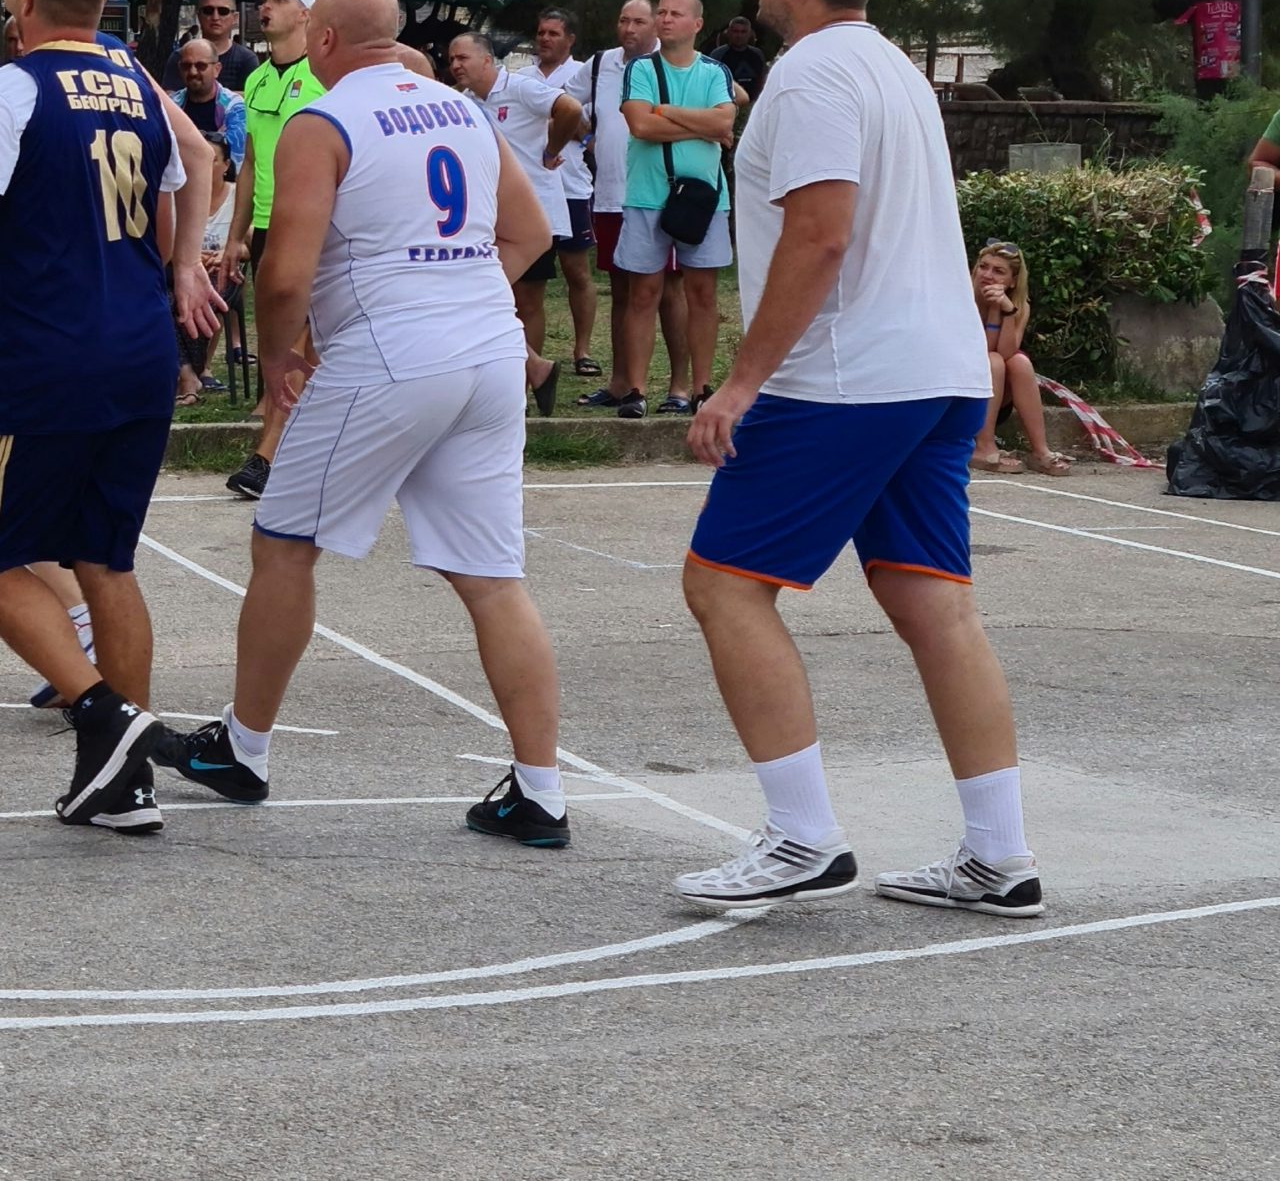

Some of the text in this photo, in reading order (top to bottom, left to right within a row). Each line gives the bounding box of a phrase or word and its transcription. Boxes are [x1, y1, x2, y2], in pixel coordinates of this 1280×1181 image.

[56, 69, 144, 102] ГСП
[66, 95, 148, 120] БЕОГРАД
[372, 99, 478, 137] ВОДОВОД
[89, 128, 150, 242] 10
[426, 145, 468, 238] 9
